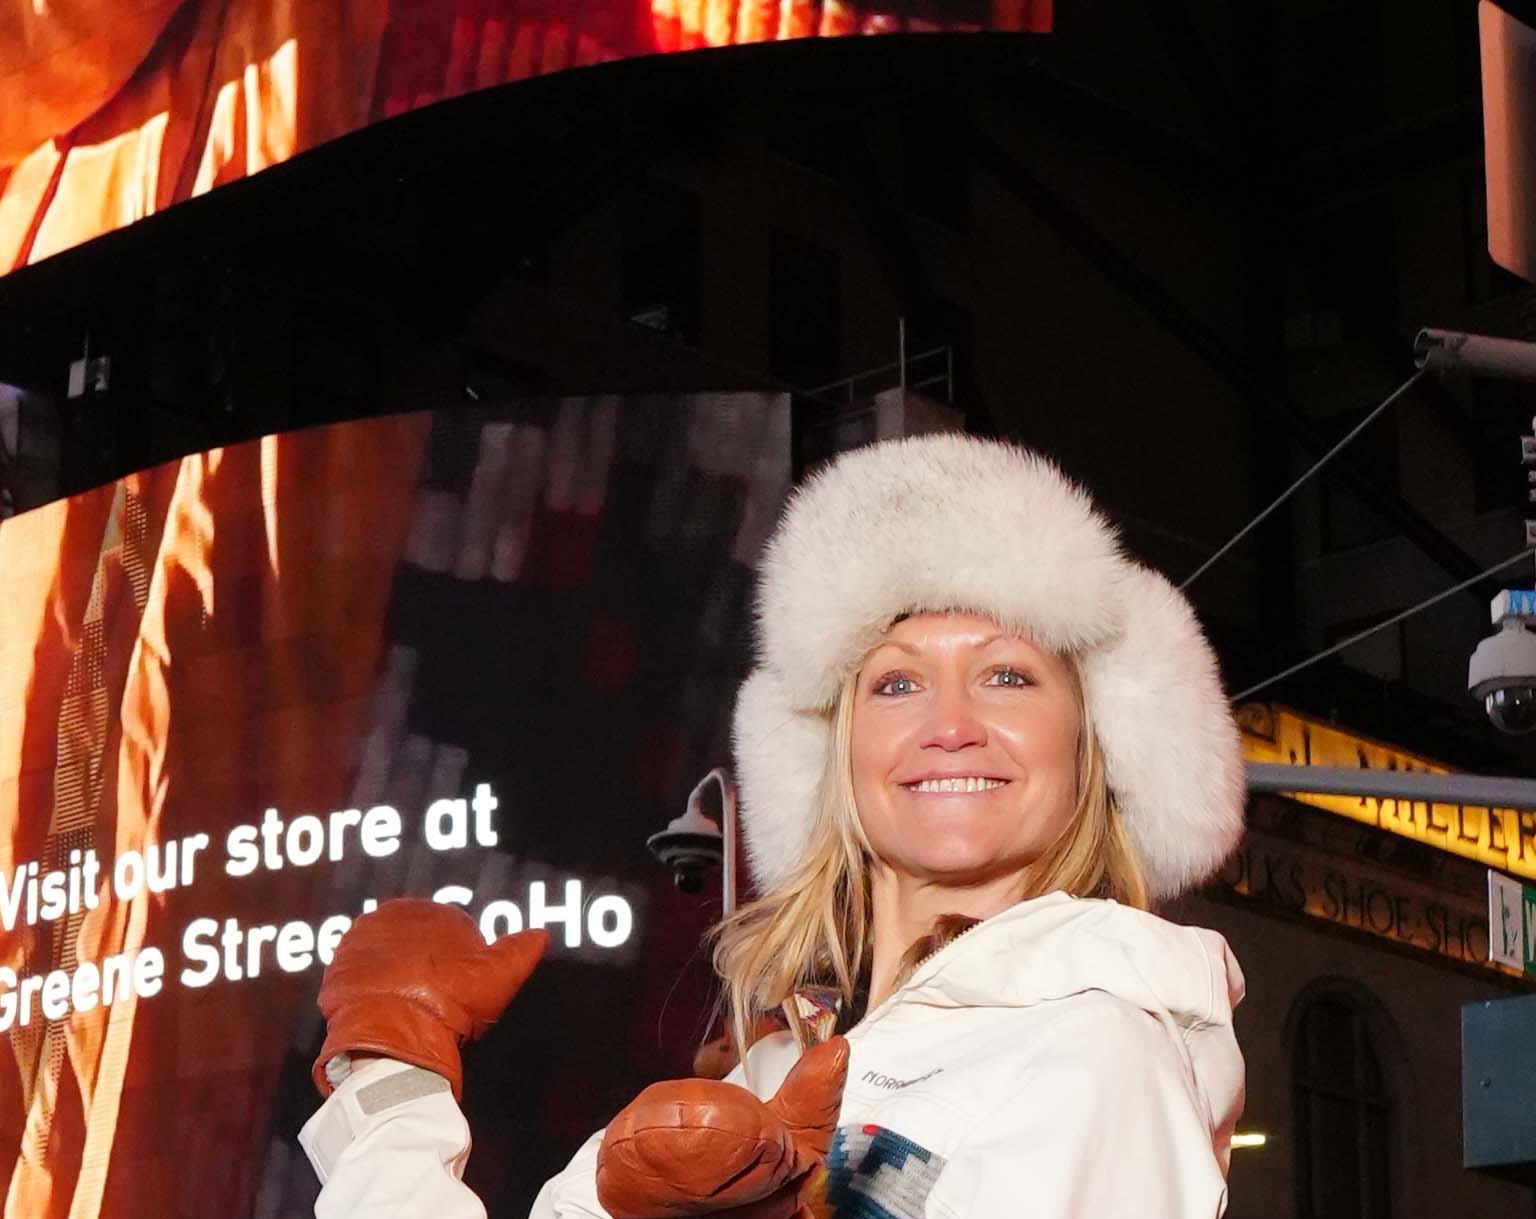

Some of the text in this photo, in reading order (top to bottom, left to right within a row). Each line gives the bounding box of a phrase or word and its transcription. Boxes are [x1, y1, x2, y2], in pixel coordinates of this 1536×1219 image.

[114, 833, 209, 900] our
[225, 806, 402, 877] store
[424, 784, 498, 851] at
[181, 900, 378, 988] Stree
[432, 880, 633, 948] oHo
